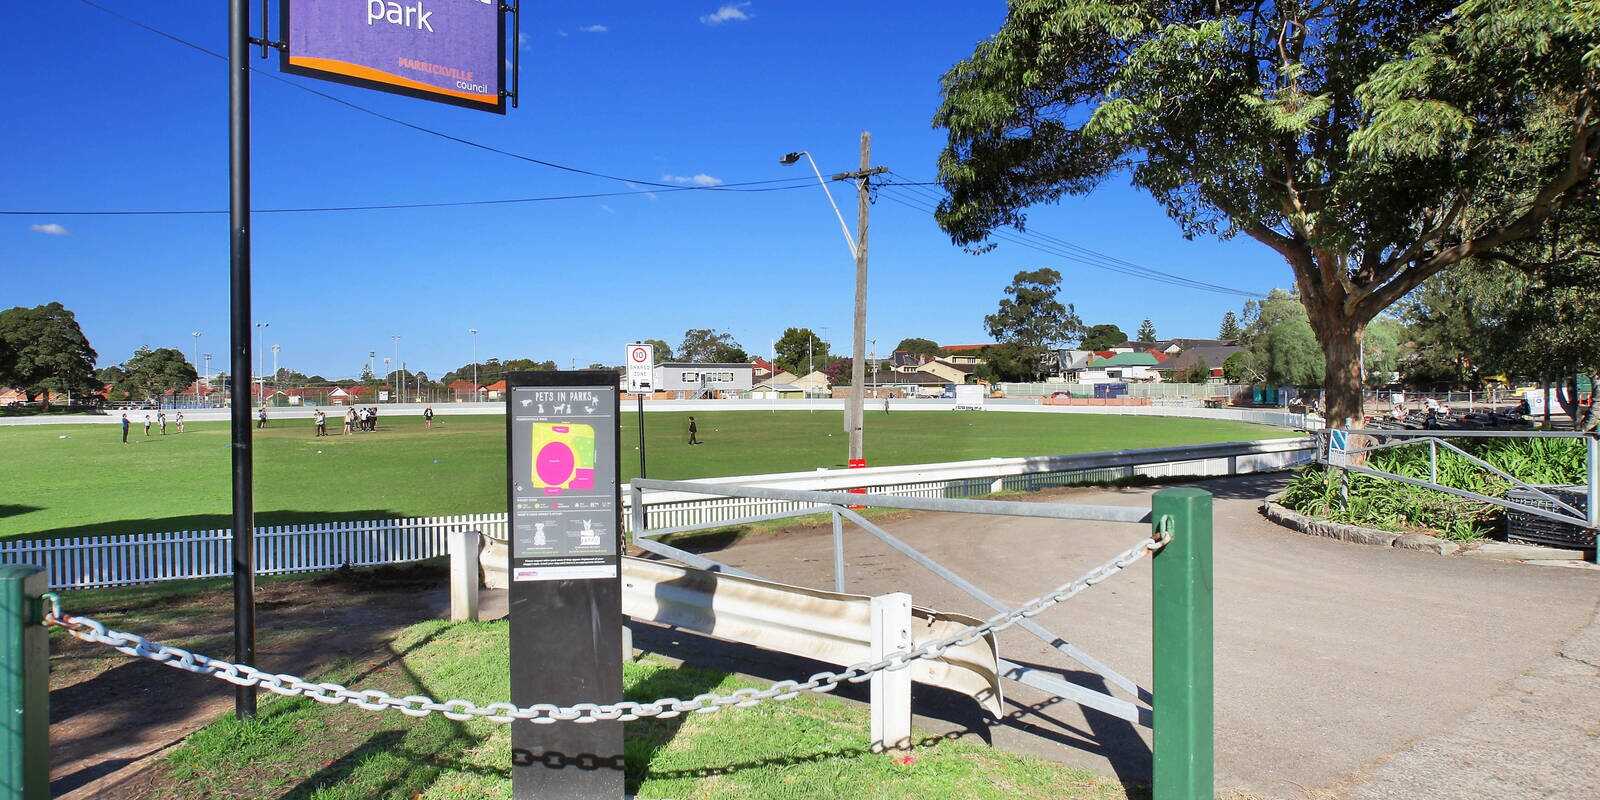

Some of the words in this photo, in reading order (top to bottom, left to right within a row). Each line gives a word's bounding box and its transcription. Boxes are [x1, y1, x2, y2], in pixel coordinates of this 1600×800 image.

[367, 0, 434, 33] park
[398, 57, 473, 80] MARRICKVILLE
[456, 80, 488, 94] council
[535, 391, 554, 402] PETS
[557, 391, 566, 402] IN
[569, 391, 592, 402] PARKS
